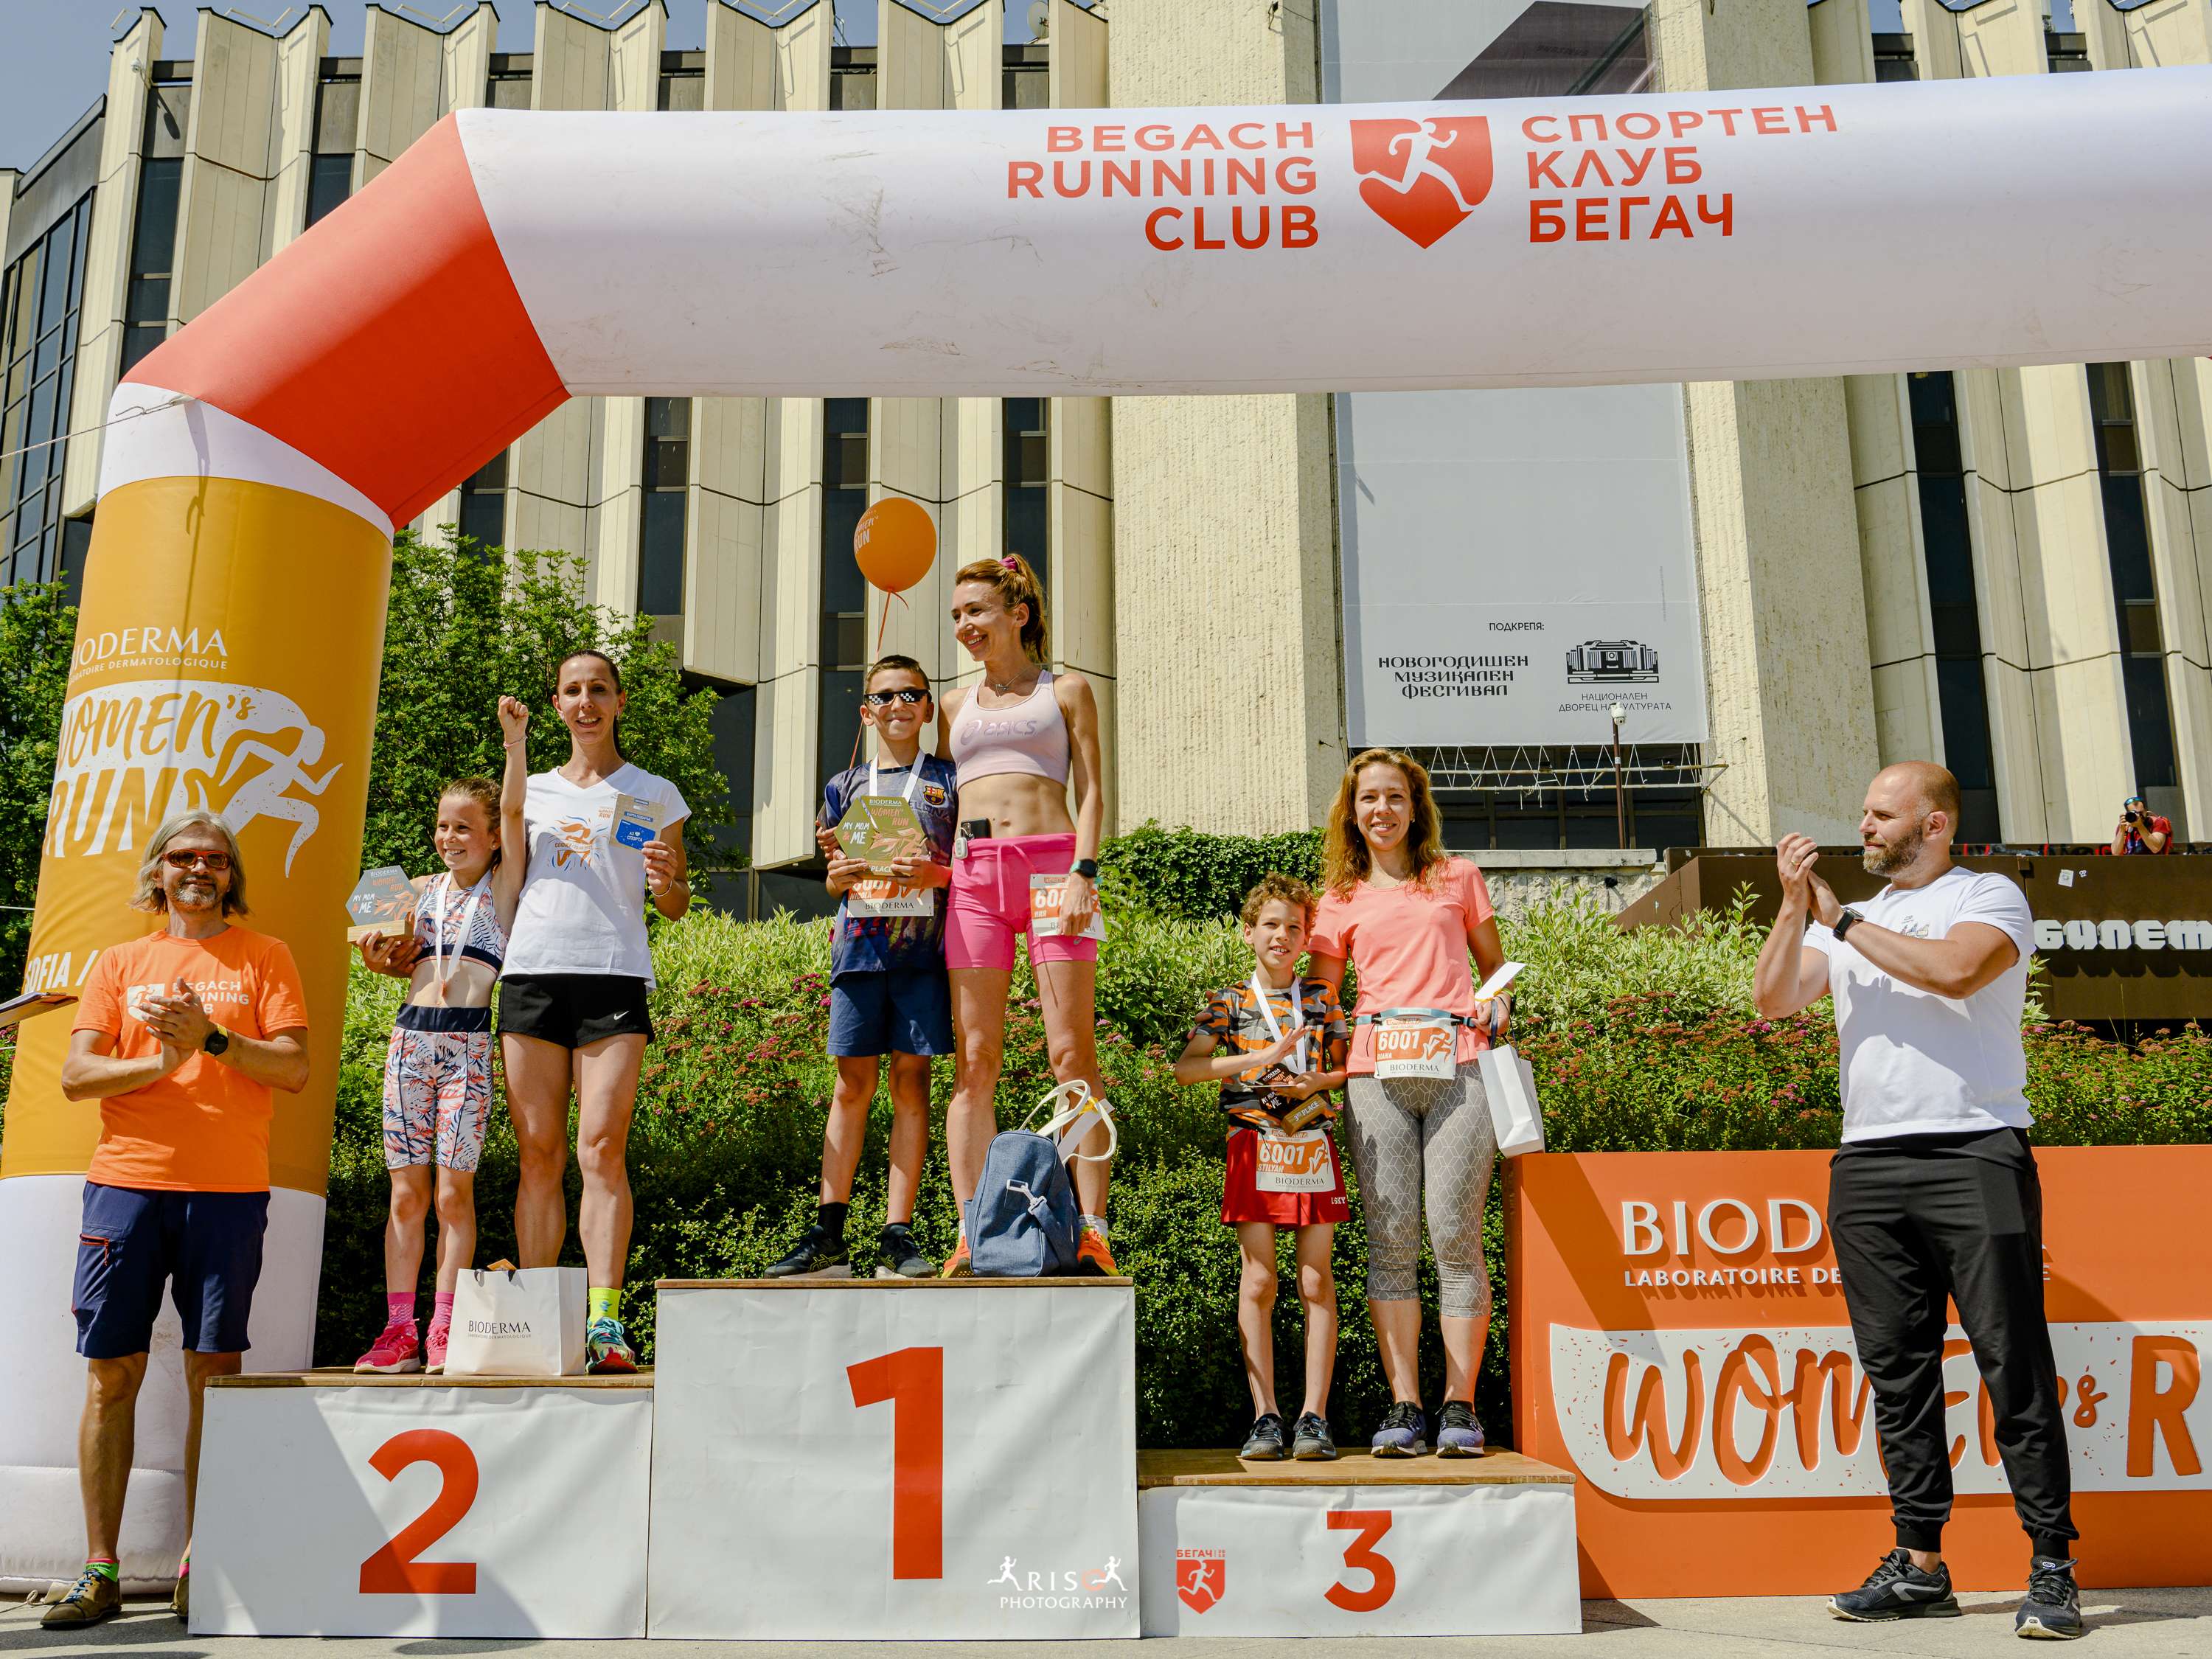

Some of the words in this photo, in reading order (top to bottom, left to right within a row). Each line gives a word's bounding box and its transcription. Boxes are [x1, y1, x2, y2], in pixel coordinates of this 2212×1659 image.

[1522, 105, 1837, 143] СПОРТЕН
[1047, 122, 1313, 153] BEGACH
[1527, 146, 1703, 189] КЛУБ
[1007, 156, 1317, 199] RUNNING
[1529, 192, 1733, 243] БЕГАЧ
[1145, 204, 1320, 251] CLUB
[1489, 622, 1545, 632] ПОДКРЕПЯ:
[72, 626, 228, 672] IODERMA
[108, 656, 228, 669] DERMATOLOGIQUE
[1378, 655, 1528, 669] НОВОГОДИШЕН
[1394, 670, 1514, 684] МУЗИКАЛЕН
[1402, 684, 1508, 699] ФЕСТИВАЛ
[1582, 692, 1648, 701] НАЦИОНАЛЕН
[1558, 703, 1599, 713] ДВОРЕЦ
[1622, 702, 1672, 711] УЛТУРАТА
[842, 821, 853, 830] MY
[855, 821, 870, 830] MOM
[891, 817, 909, 827] RUN
[849, 831, 866, 844] ME
[358, 901, 372, 914] ME
[1378, 1030, 1421, 1051] 6001
[1389, 1063, 1440, 1072] BIODERMA
[1270, 1096, 1282, 1109] ME
[1301, 1100, 1320, 1116] PLACE
[1259, 1142, 1305, 1165] 6001
[1275, 1176, 1325, 1186] BIODERMA
[1621, 1198, 1823, 1255] BIOD
[1624, 1267, 1801, 1286] LABORATOIRE
[468, 1320, 531, 1335] BIODERMA
[846, 1346, 944, 1581] 1
[359, 1428, 479, 1595] 2
[1176, 1549, 1213, 1558] БЕГАЧ
[1324, 1509, 1397, 1613] 3
